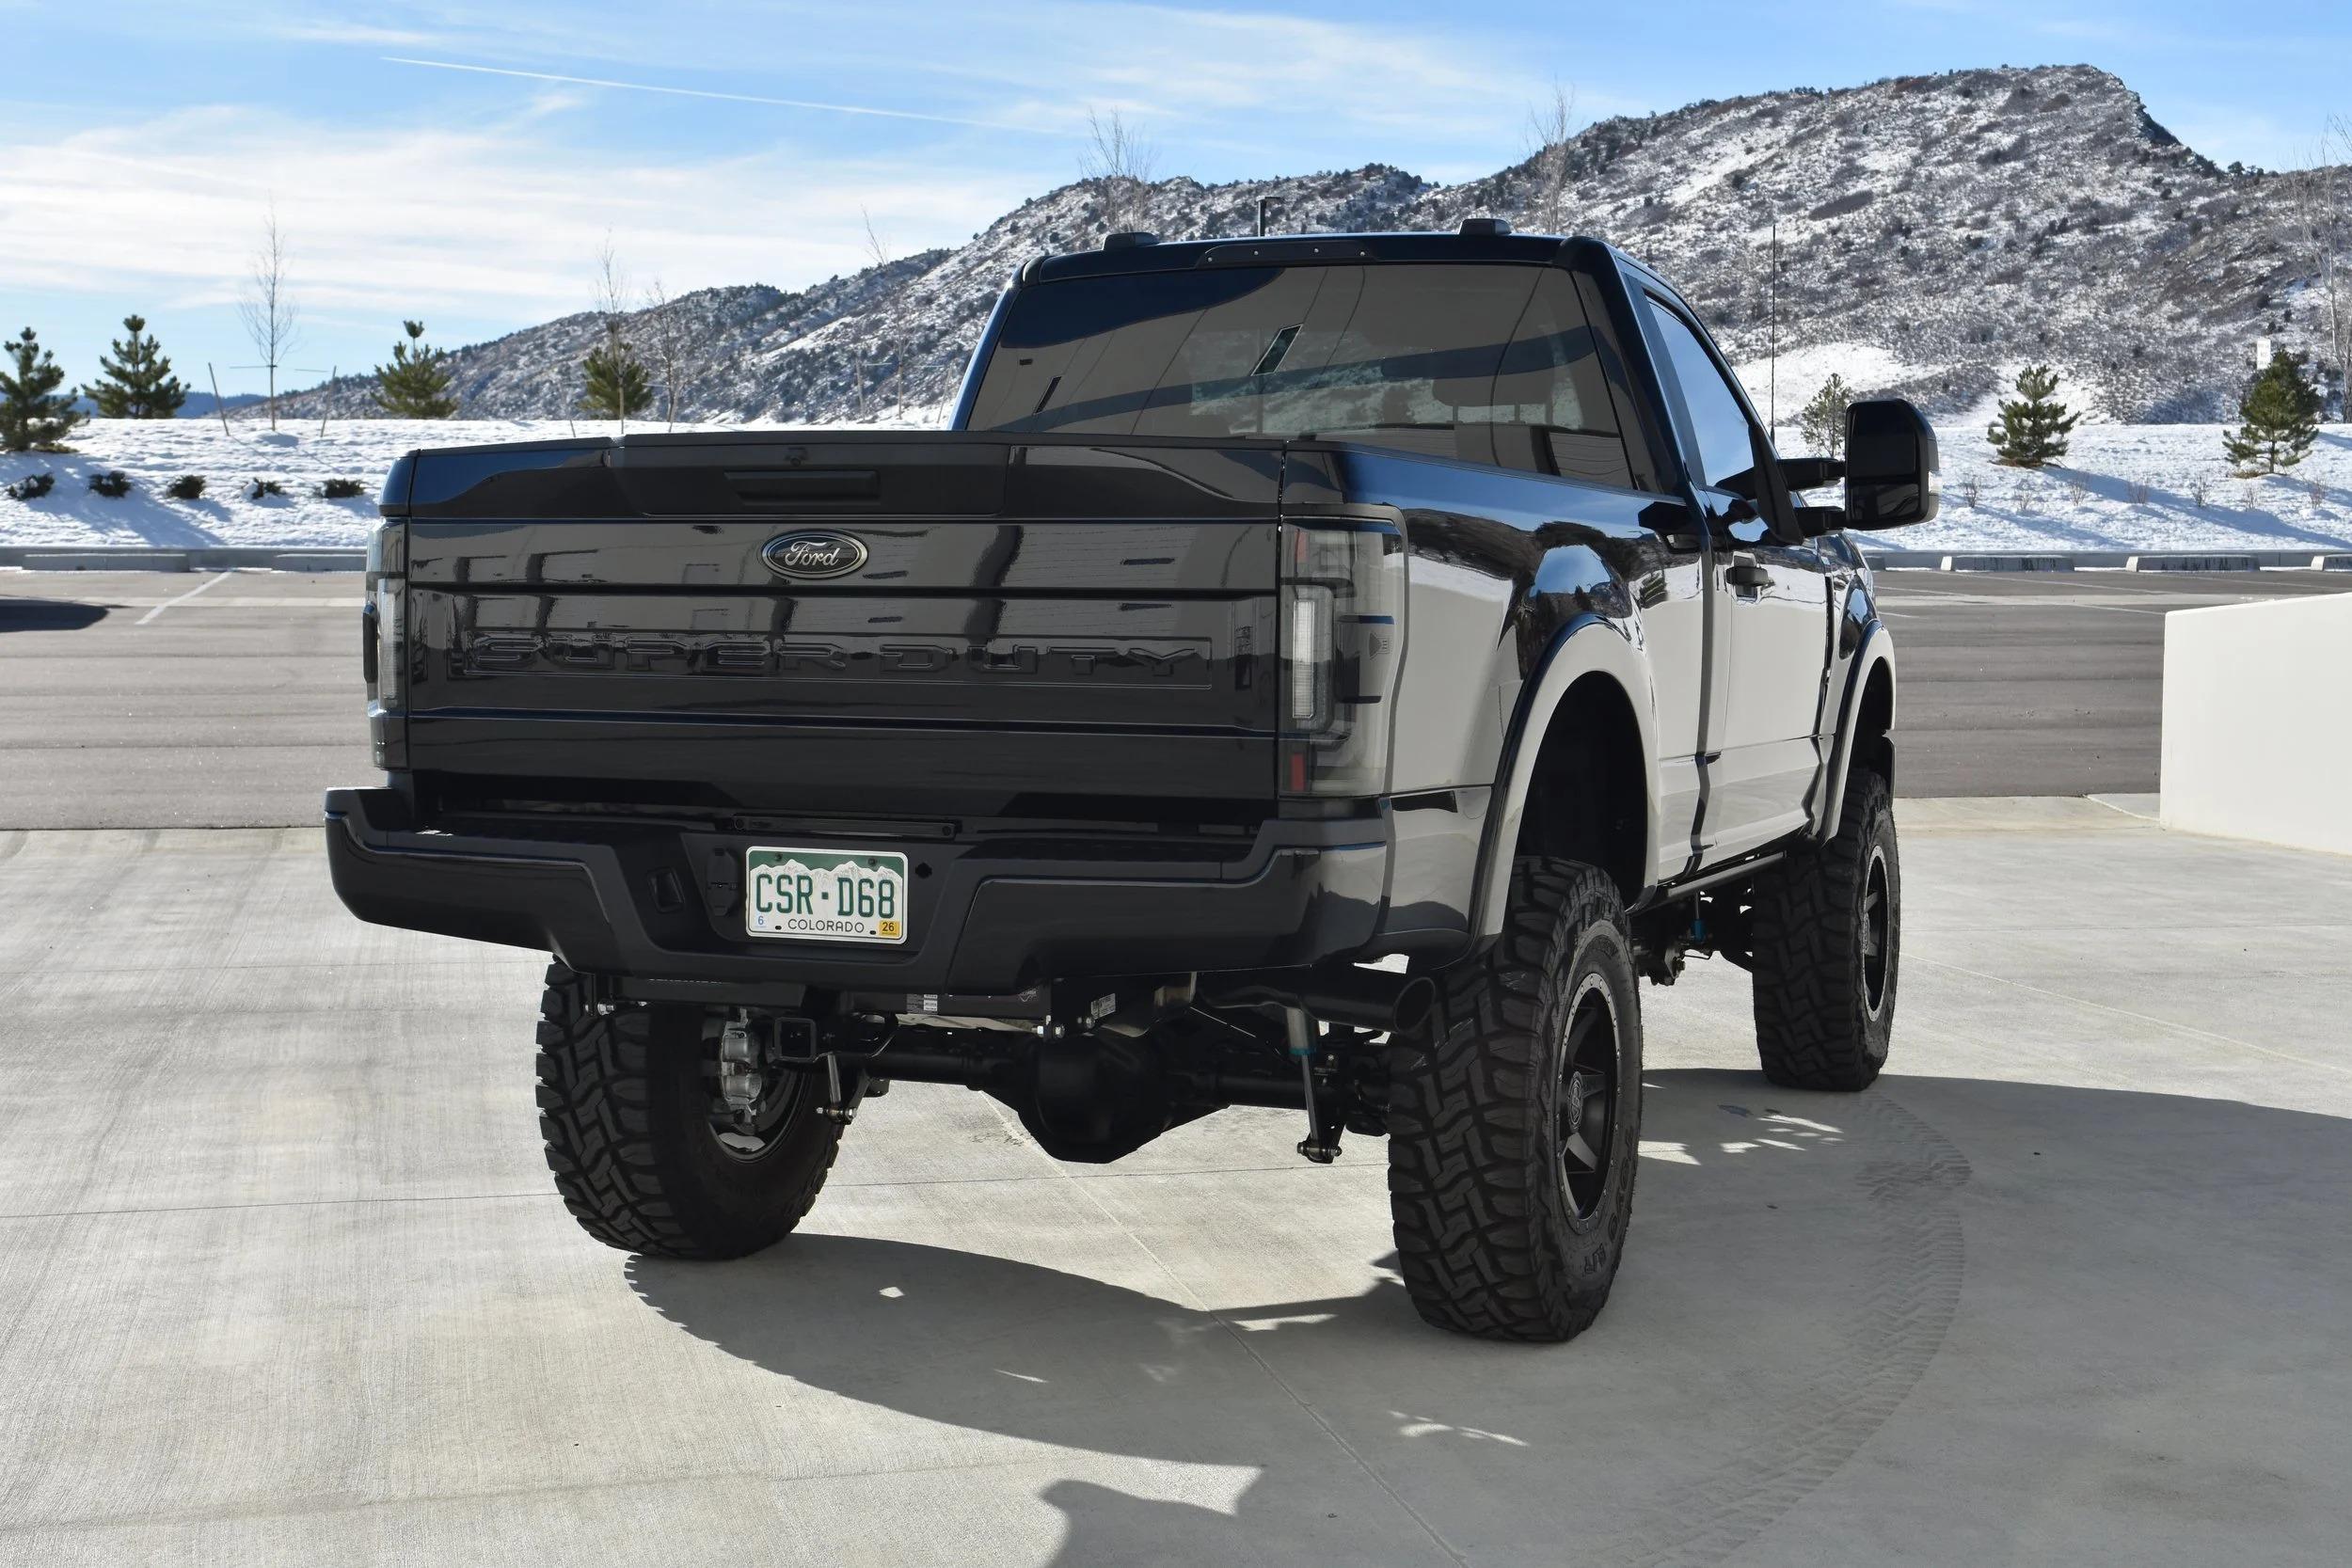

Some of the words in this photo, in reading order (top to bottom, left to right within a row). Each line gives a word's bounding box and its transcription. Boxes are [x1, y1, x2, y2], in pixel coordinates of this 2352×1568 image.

[785, 540, 840, 566] Ford
[472, 635, 846, 674] SUPER
[880, 643, 1200, 676] DUTY
[757, 915, 764, 926] 6
[787, 918, 865, 933] COLORADO
[882, 921, 895, 932] 26
